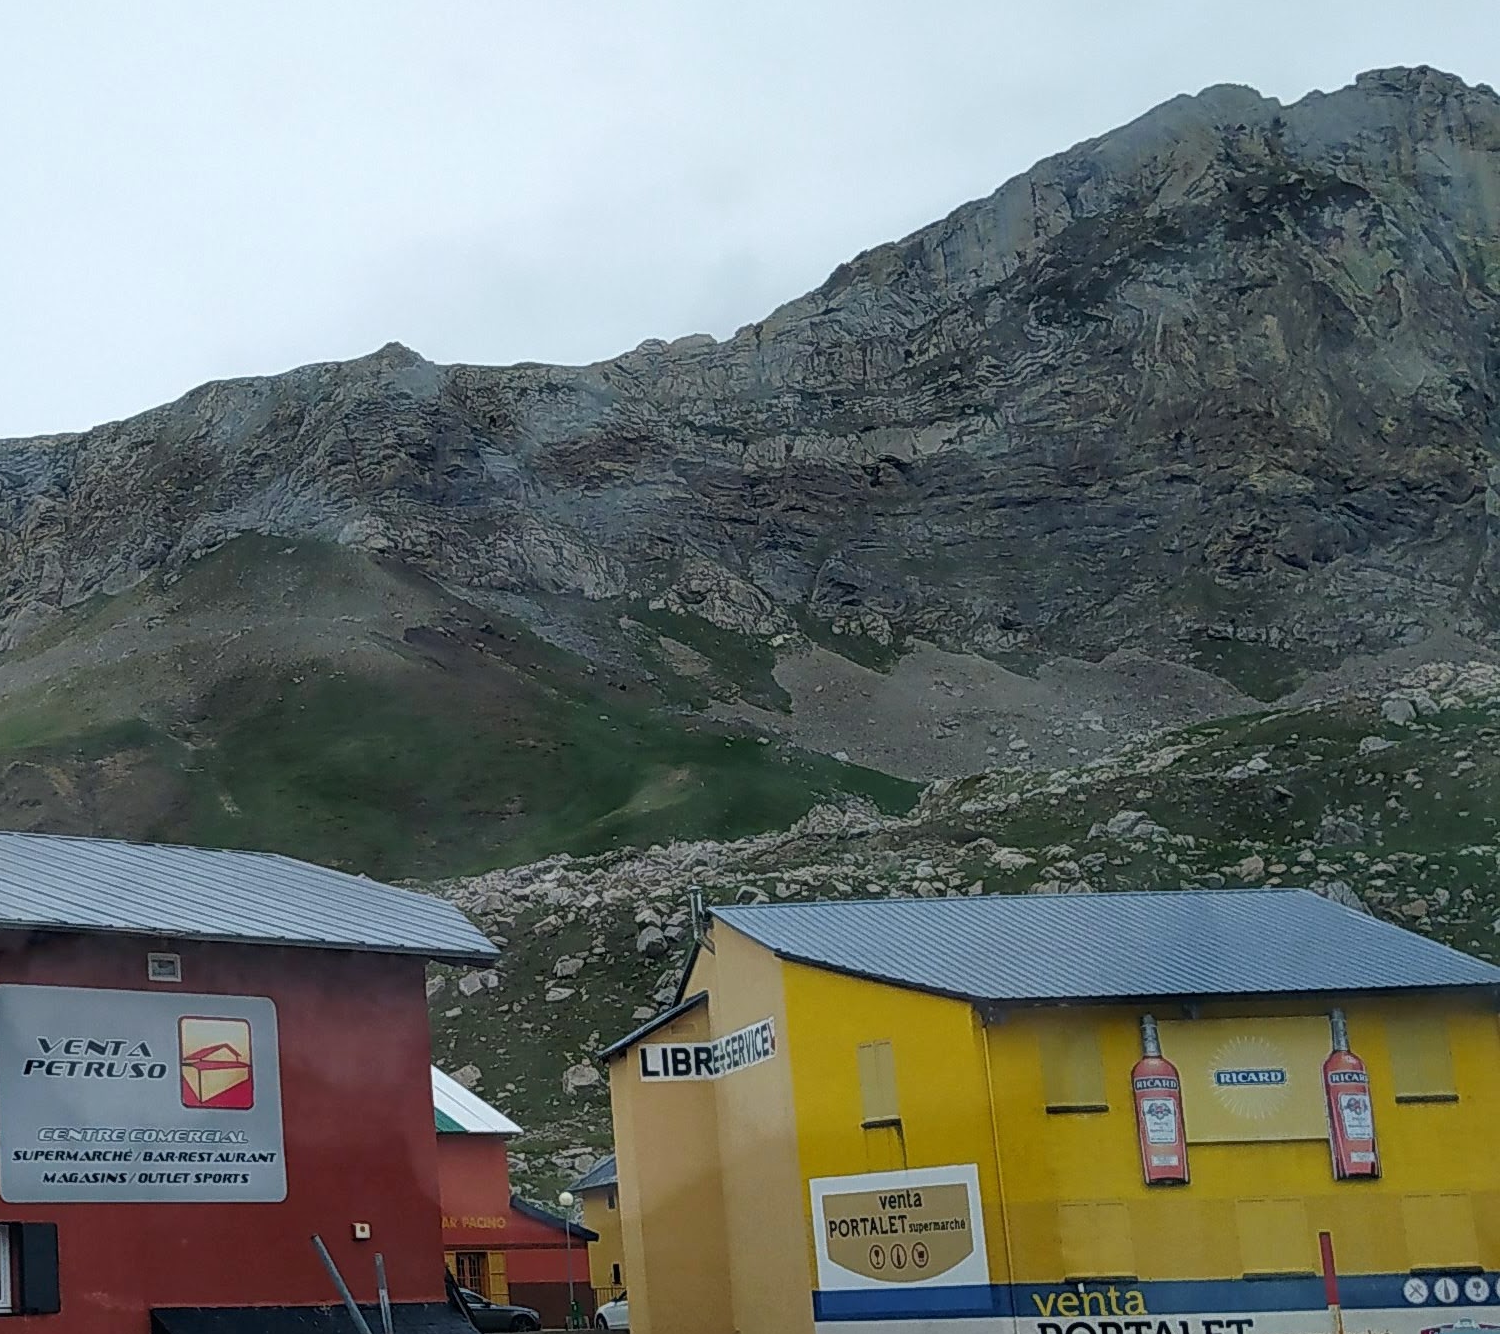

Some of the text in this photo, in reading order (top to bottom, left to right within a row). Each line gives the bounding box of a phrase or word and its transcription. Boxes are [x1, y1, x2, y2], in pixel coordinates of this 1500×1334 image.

[37, 1037, 152, 1058] VENTA
[23, 1059, 167, 1079] PETRUSO
[1220, 1070, 1282, 1083] RICARD
[1136, 1079, 1178, 1090] RICARD
[38, 1127, 249, 1144] CENTRE COMERCIAL
[193, 1173, 250, 1184] SPORTS
[879, 1189, 923, 1210] venta
[828, 1214, 908, 1238] PORTALET
[1032, 1285, 1148, 1317] venta
